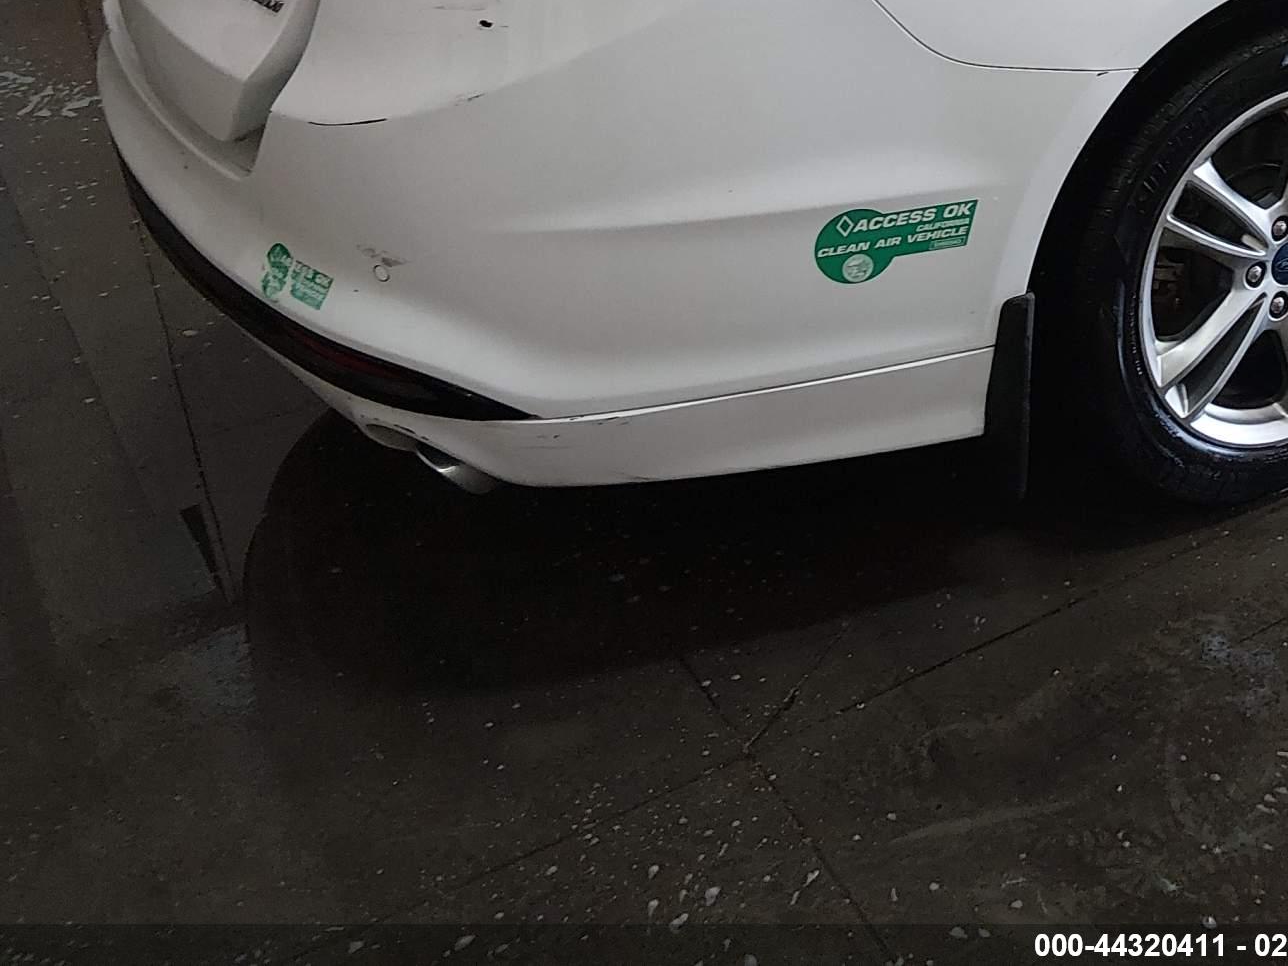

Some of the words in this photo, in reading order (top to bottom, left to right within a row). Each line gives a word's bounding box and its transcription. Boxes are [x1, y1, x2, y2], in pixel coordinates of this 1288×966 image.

[852, 208, 937, 233] ACCESS
[943, 202, 975, 218] OK
[817, 241, 870, 258] CLEAN
[874, 236, 901, 249] AIR
[907, 225, 969, 243] VEHICLE
